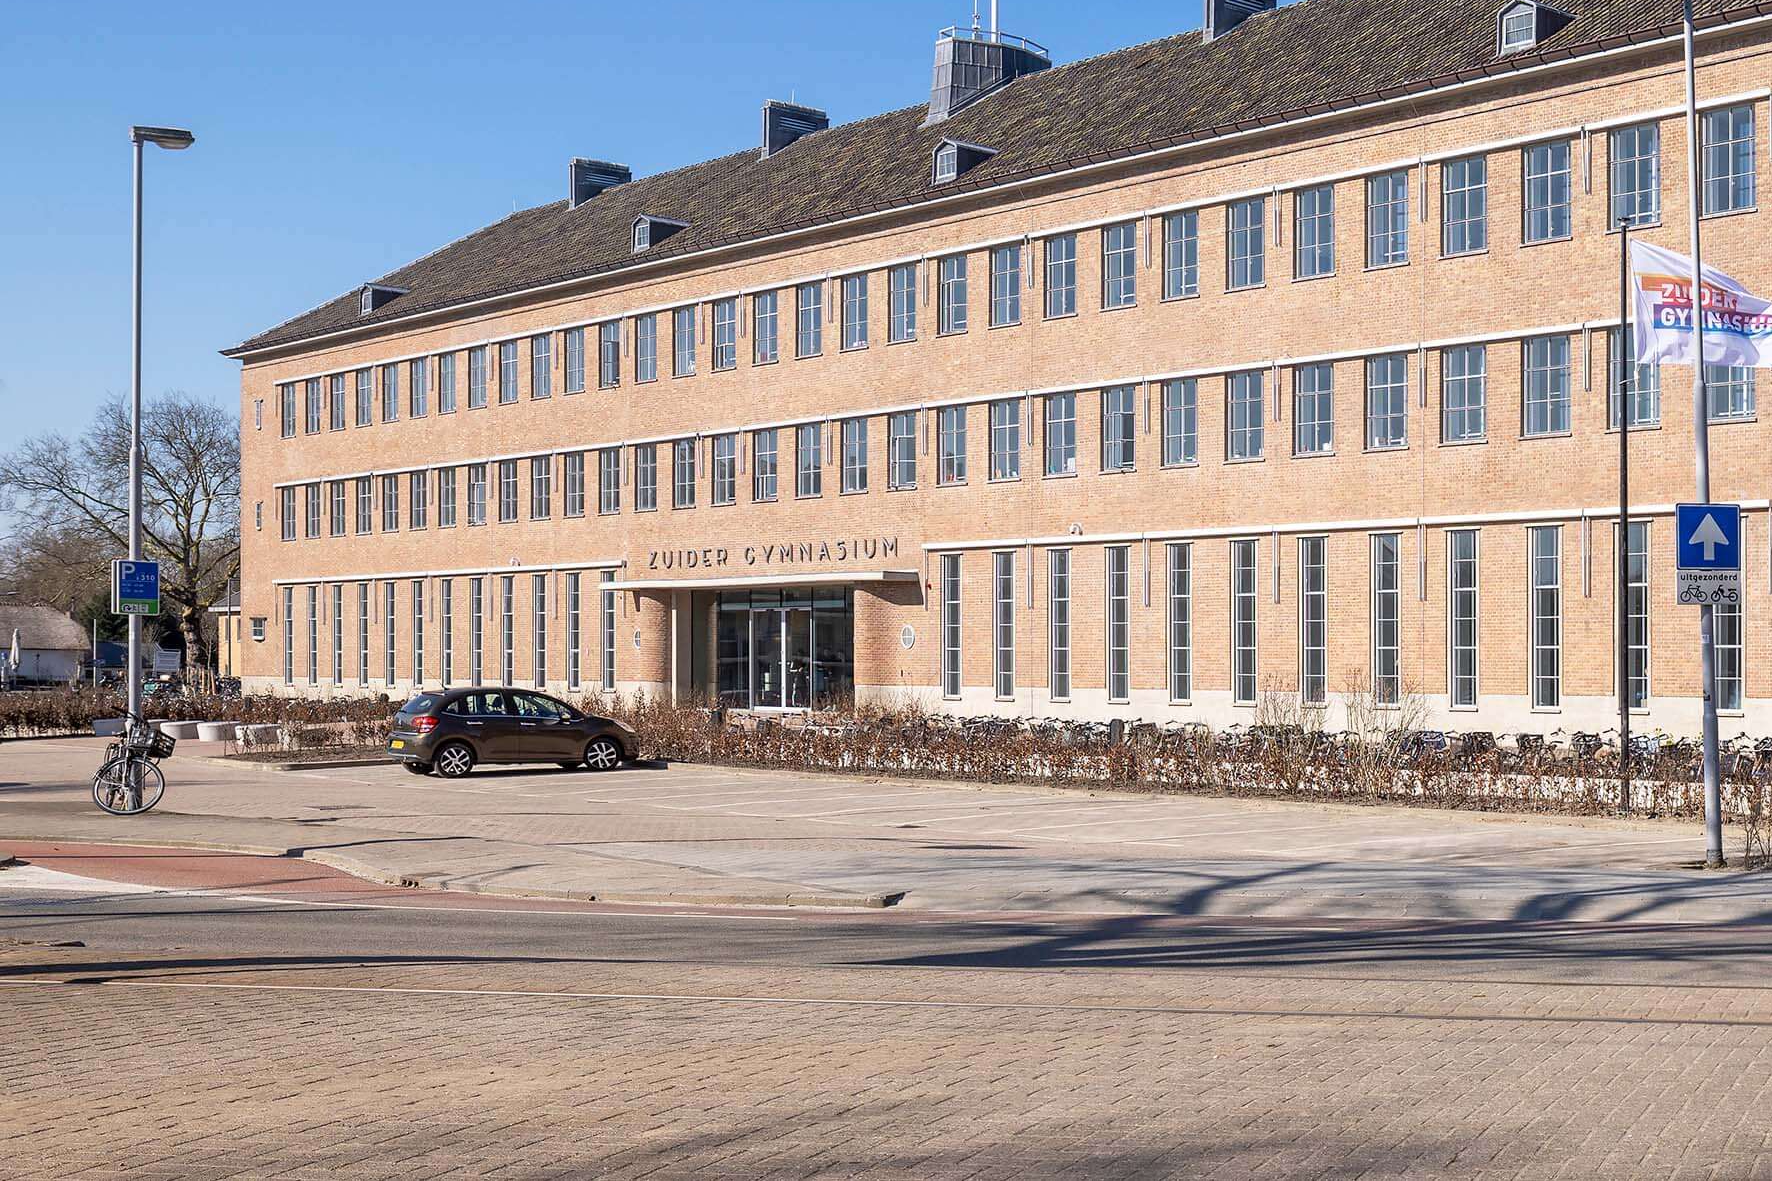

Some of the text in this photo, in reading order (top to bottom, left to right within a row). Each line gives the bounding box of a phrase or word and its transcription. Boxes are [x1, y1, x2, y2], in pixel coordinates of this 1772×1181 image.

[648, 536, 899, 569] ZUIDER GYMNASIUM
[121, 563, 135, 580] P
[1680, 573, 1738, 583] uitgezonderd
